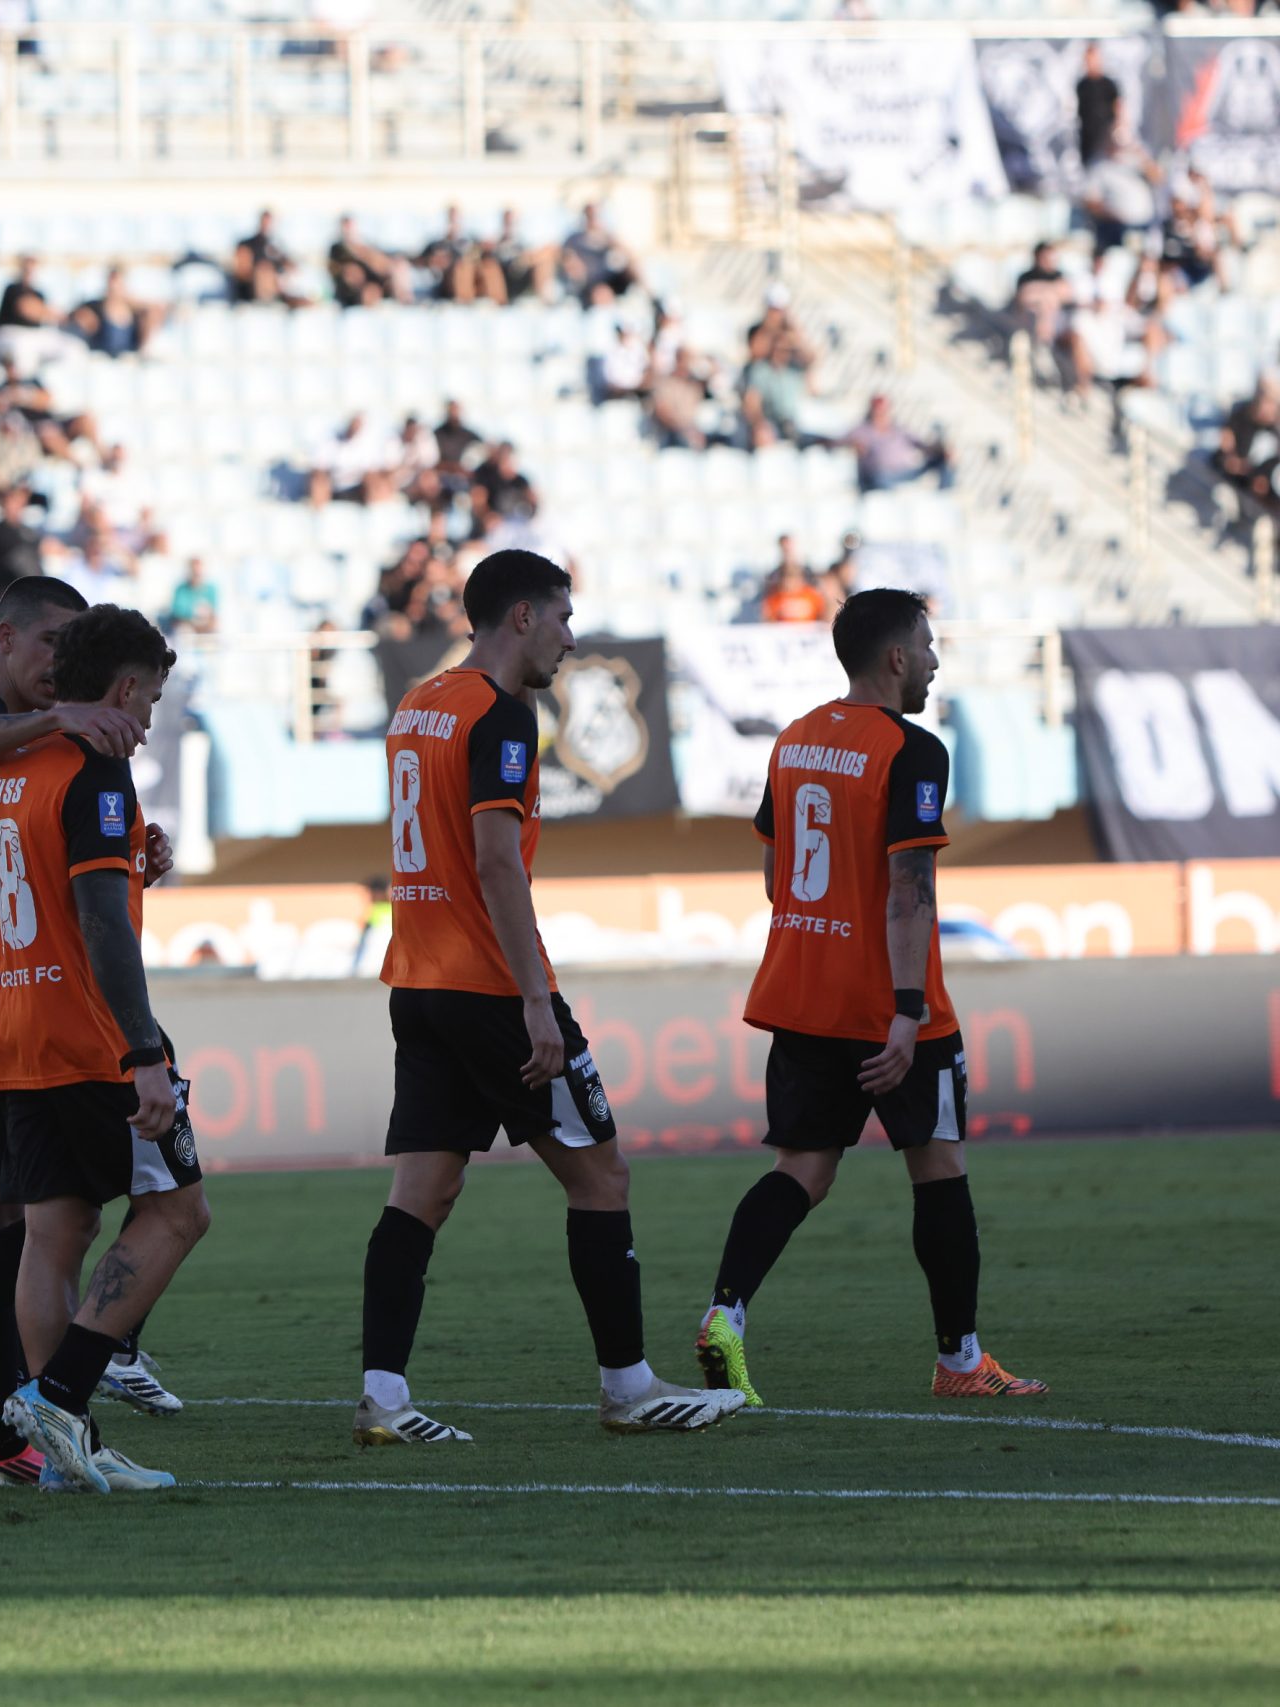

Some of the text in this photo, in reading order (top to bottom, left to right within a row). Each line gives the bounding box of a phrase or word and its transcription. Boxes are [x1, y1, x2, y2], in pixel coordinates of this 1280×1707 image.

[778, 744, 868, 778] KARACHALIOS
[391, 749, 427, 873] 8
[791, 783, 832, 902] 6
[830, 920, 852, 938] FC
[35, 965, 62, 983] FC
